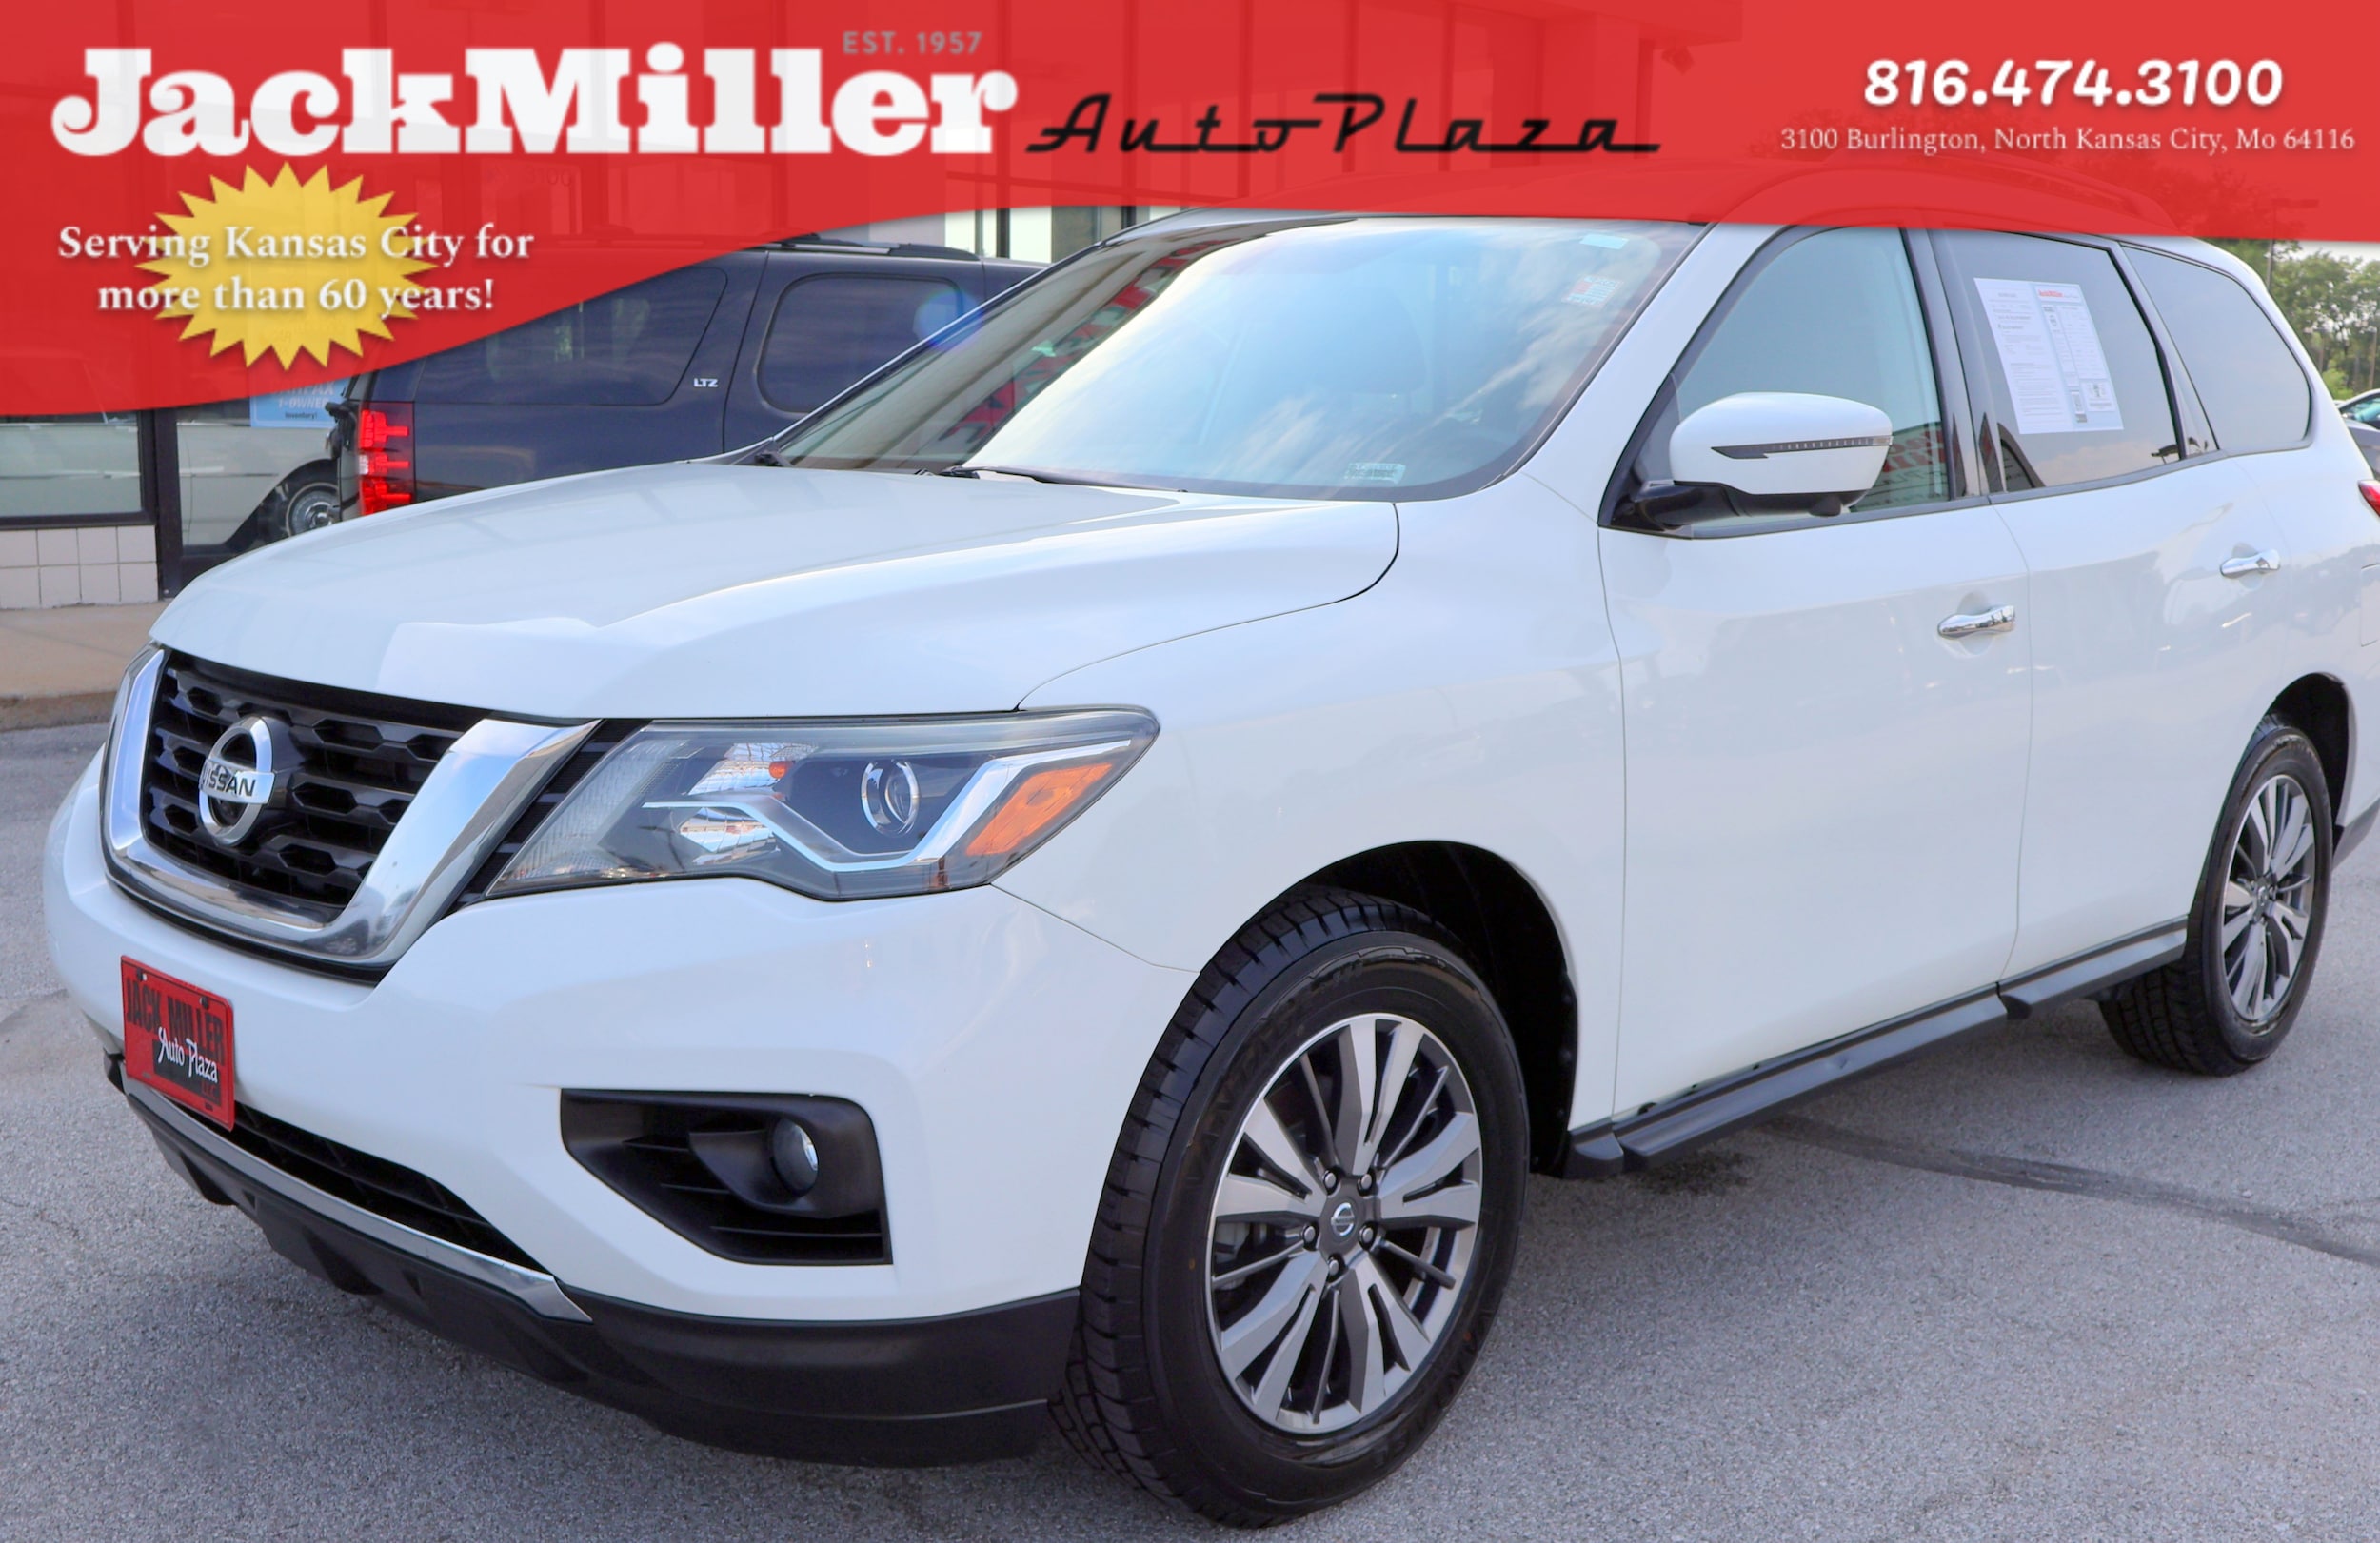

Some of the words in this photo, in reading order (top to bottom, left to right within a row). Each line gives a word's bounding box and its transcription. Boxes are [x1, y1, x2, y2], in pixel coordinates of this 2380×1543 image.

[694, 378, 718, 387] LTZ
[127, 977, 161, 1037] JACK
[168, 997, 225, 1066] MILLER
[158, 1026, 185, 1064] Auto
[186, 1037, 218, 1083] Plaza
